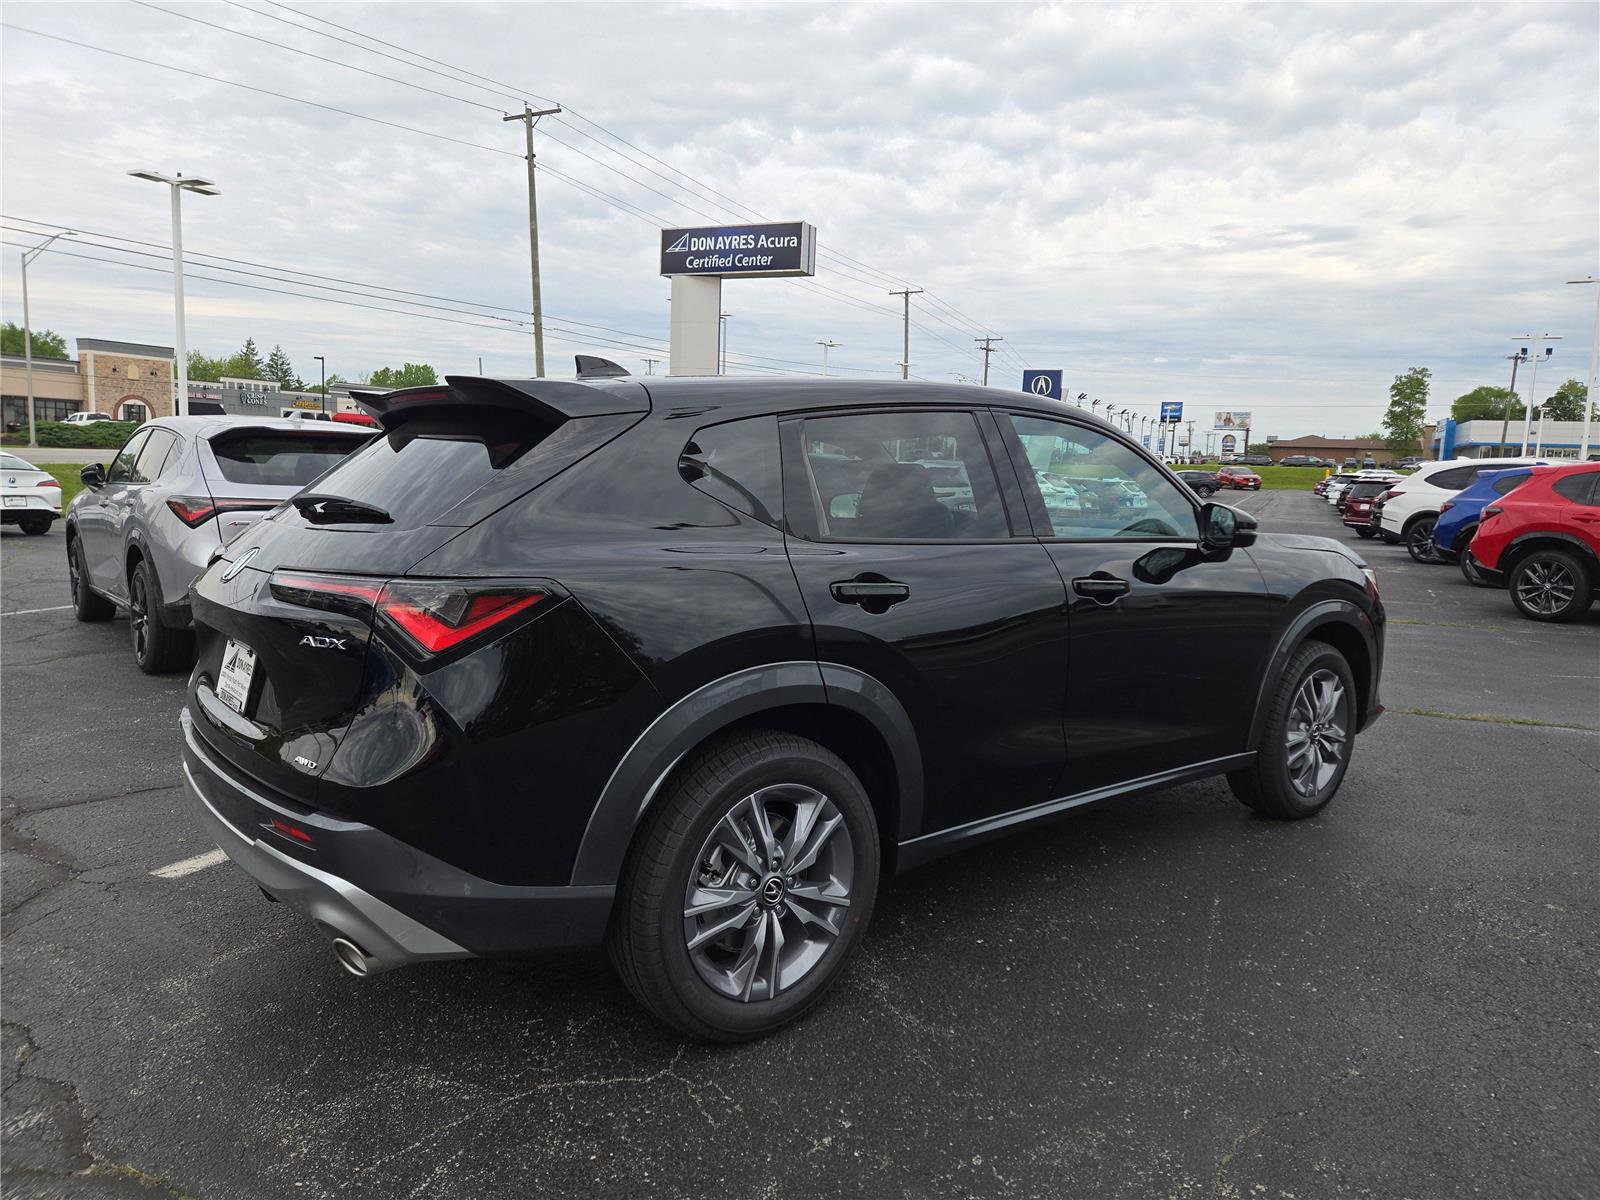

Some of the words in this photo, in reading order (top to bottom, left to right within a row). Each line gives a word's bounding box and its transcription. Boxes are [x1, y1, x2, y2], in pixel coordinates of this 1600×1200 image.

[691, 237, 715, 251] DON
[716, 235, 754, 250] AYRES
[757, 234, 798, 248] Acura
[686, 254, 732, 268] Certified
[735, 254, 773, 267] Center
[299, 635, 346, 650] ADX
[294, 755, 318, 769] AWD
